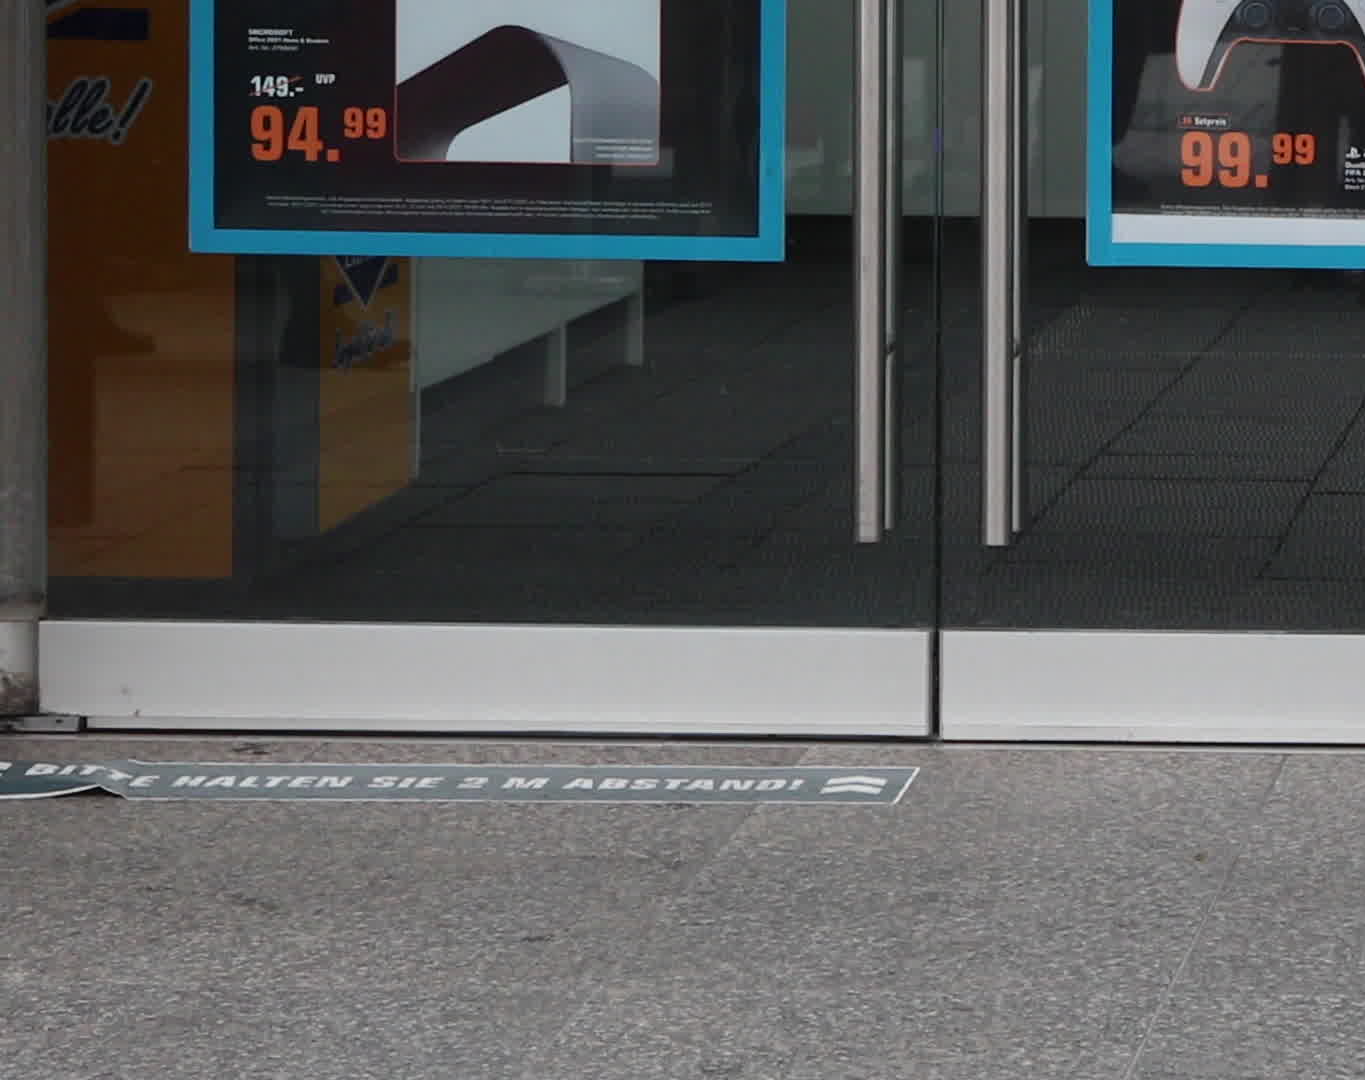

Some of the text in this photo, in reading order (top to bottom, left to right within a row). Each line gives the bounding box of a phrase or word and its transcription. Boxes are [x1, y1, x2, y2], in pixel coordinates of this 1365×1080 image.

[315, 73, 336, 85] UVP
[172, 775, 354, 789] HALTEN
[368, 775, 444, 789] SIE
[457, 776, 489, 790] 2
[502, 777, 551, 790] M
[563, 778, 807, 792] ABSTAND!
